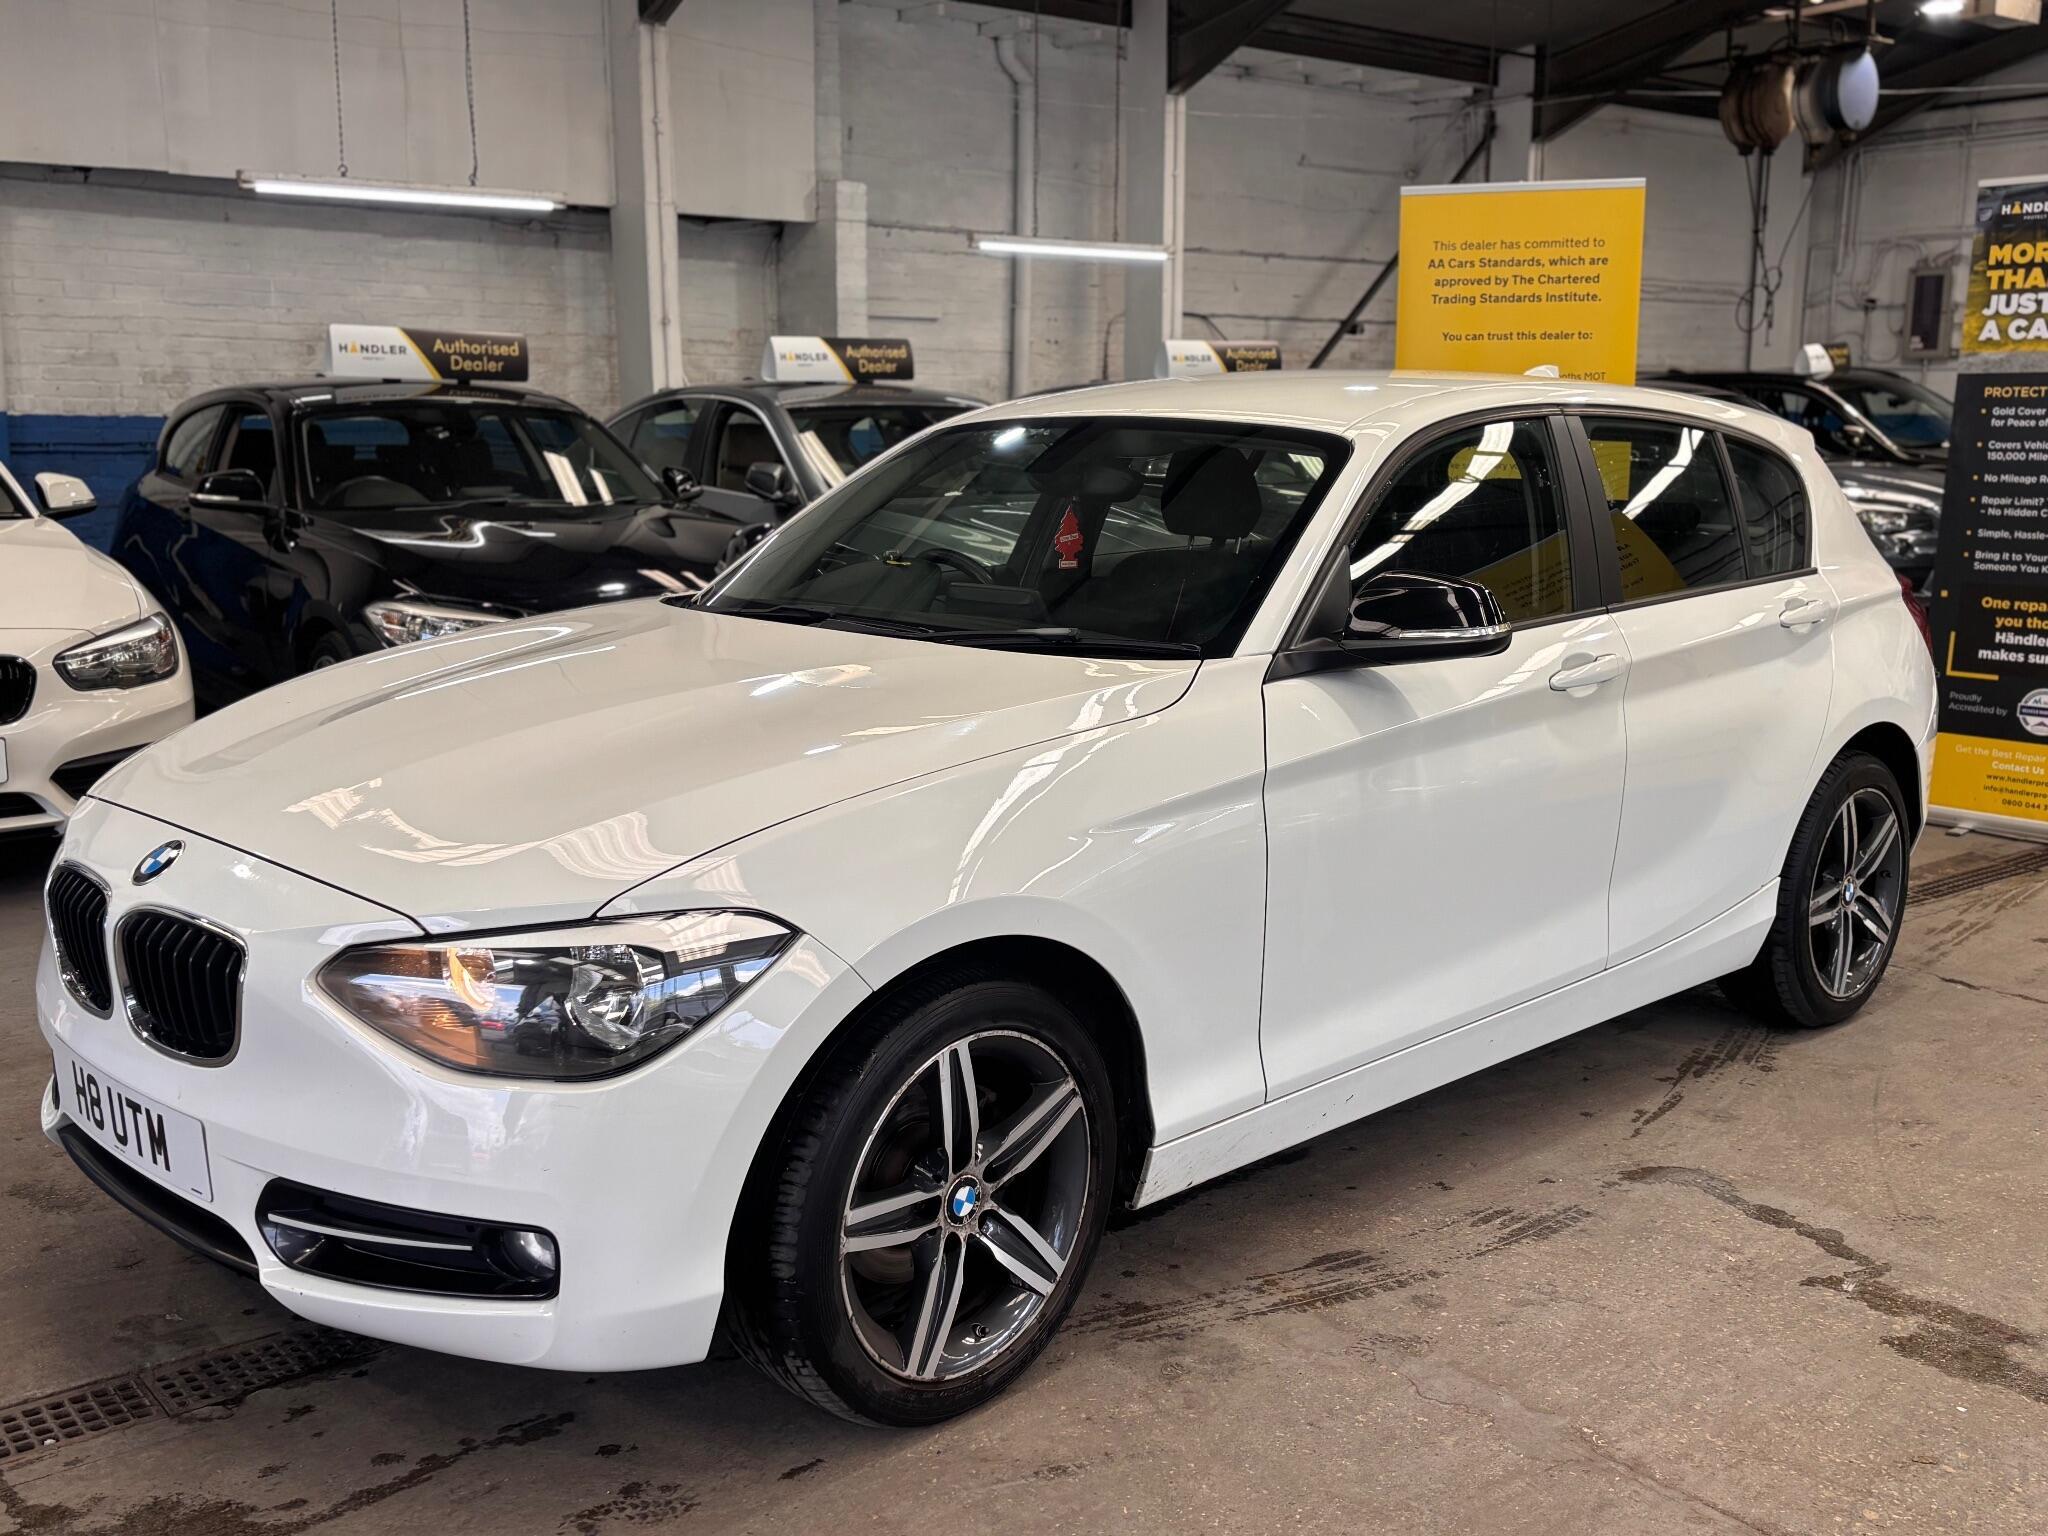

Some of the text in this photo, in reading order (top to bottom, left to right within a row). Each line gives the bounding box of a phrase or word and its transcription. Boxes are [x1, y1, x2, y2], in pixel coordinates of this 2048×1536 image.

[1433, 237, 1605, 251] This dealer has committed to
[1428, 256, 1609, 270] AA Cars Standards, which are
[1434, 273, 1600, 289] approved by The Chartered
[1986, 267, 2048, 290] THA
[1432, 292, 1602, 306] Trading Standards Institute.
[1442, 330, 1593, 342] You can trust this dealer to:
[1978, 319, 2000, 342] A
[432, 338, 519, 357] Authorised
[846, 346, 907, 359] Authorised
[450, 356, 504, 372] Dealer
[858, 359, 897, 373] Dealer
[1585, 371, 1607, 381] MOT
[1992, 406, 2046, 416] Gold Cover
[1991, 418, 2005, 427] for
[2007, 418, 2036, 427] Peace
[1988, 440, 2021, 449] Covers
[1987, 451, 2026, 462] 150,000
[1984, 474, 1998, 482] No
[2000, 474, 2037, 485] Mileage
[1981, 495, 2044, 506] Repair Limit?
[1987, 507, 2001, 516] No
[2003, 508, 2038, 517] Hidden
[1977, 528, 2012, 540] Simple,
[1974, 550, 2000, 561] Bring
[2012, 553, 2022, 561] to
[1973, 561, 2017, 572] Someone
[2020, 564, 2039, 573] You
[1981, 596, 2010, 610] One
[1995, 616, 2023, 629] you
[1978, 649, 2025, 662] makes
[1949, 690, 1982, 703] Proudly
[1948, 702, 1995, 714] Accredited
[1996, 705, 2008, 717] by
[1955, 744, 2046, 763] Get the Best Repair
[1992, 761, 2045, 775] Contact Us
[2001, 798, 2023, 807] 0800
[2025, 801, 2041, 810] 044
[72, 1060, 171, 1172] H8 UTM
